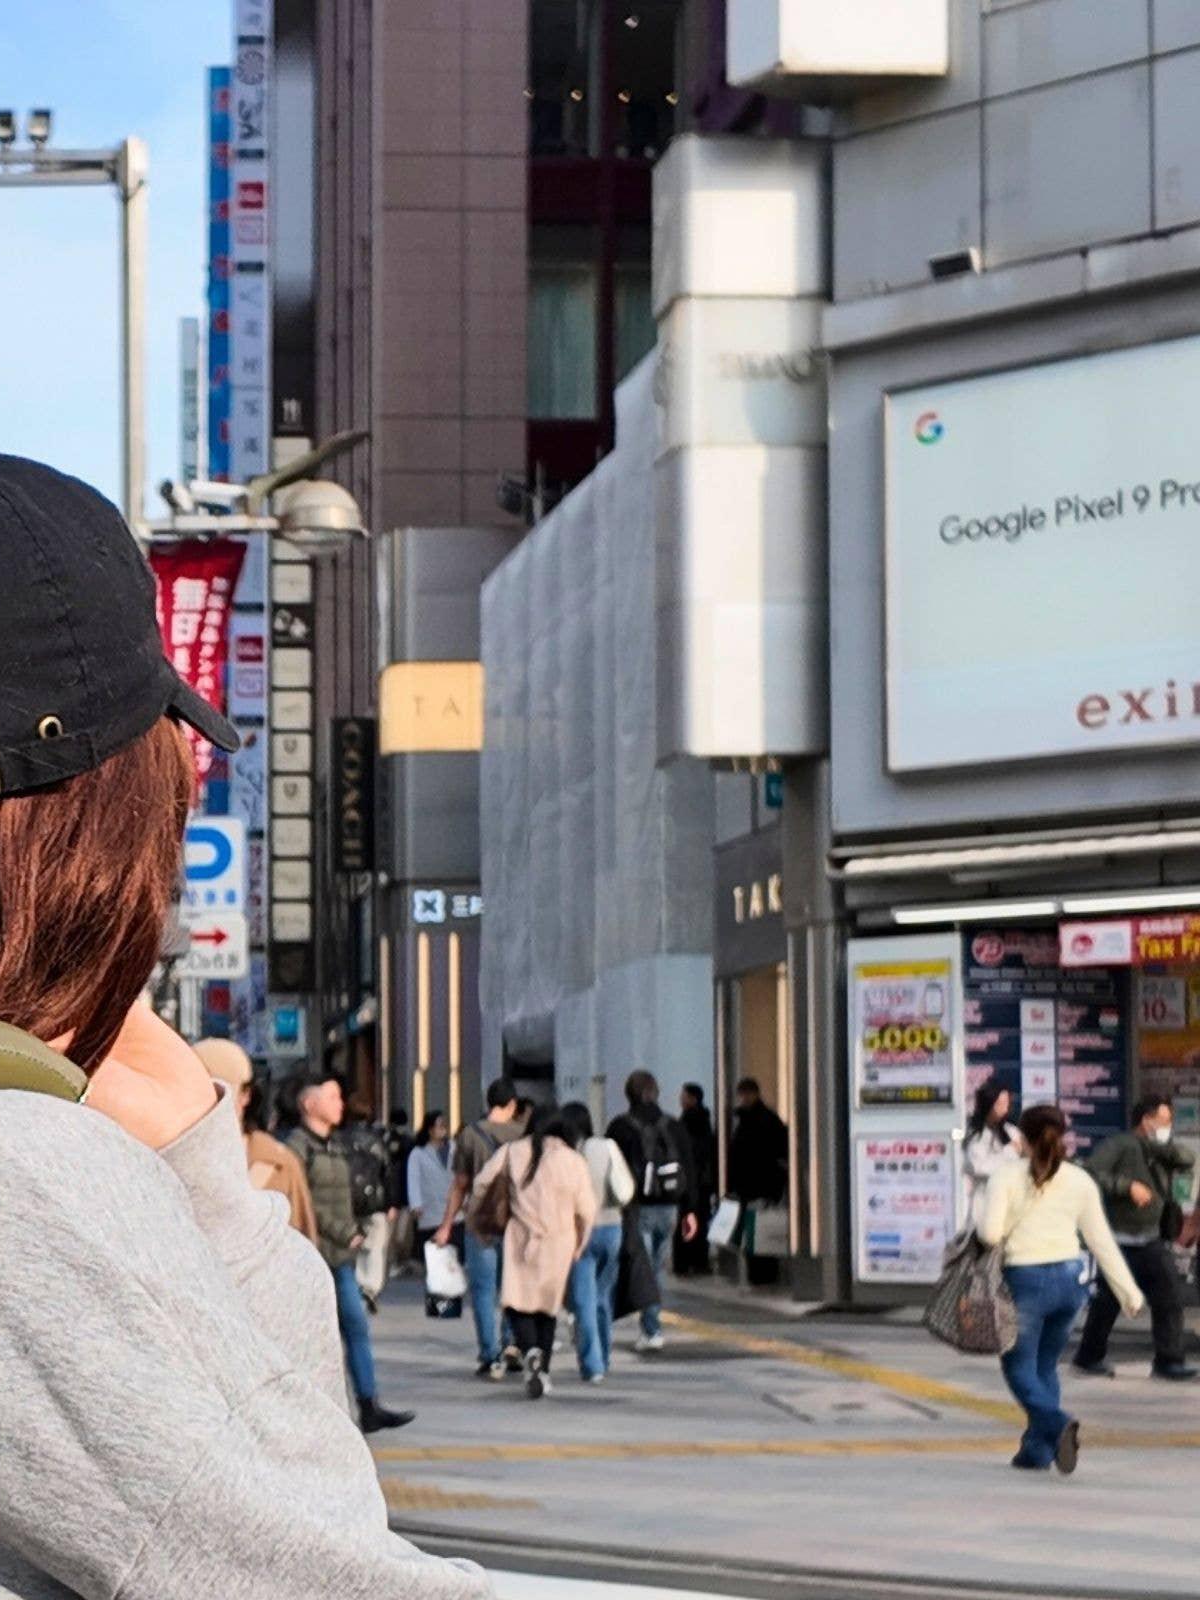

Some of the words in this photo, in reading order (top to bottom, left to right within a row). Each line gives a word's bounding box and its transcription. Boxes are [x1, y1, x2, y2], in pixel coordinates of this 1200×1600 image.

[939, 504, 1047, 545] Google
[1055, 488, 1124, 527] Pixel
[1131, 484, 1152, 512] 9
